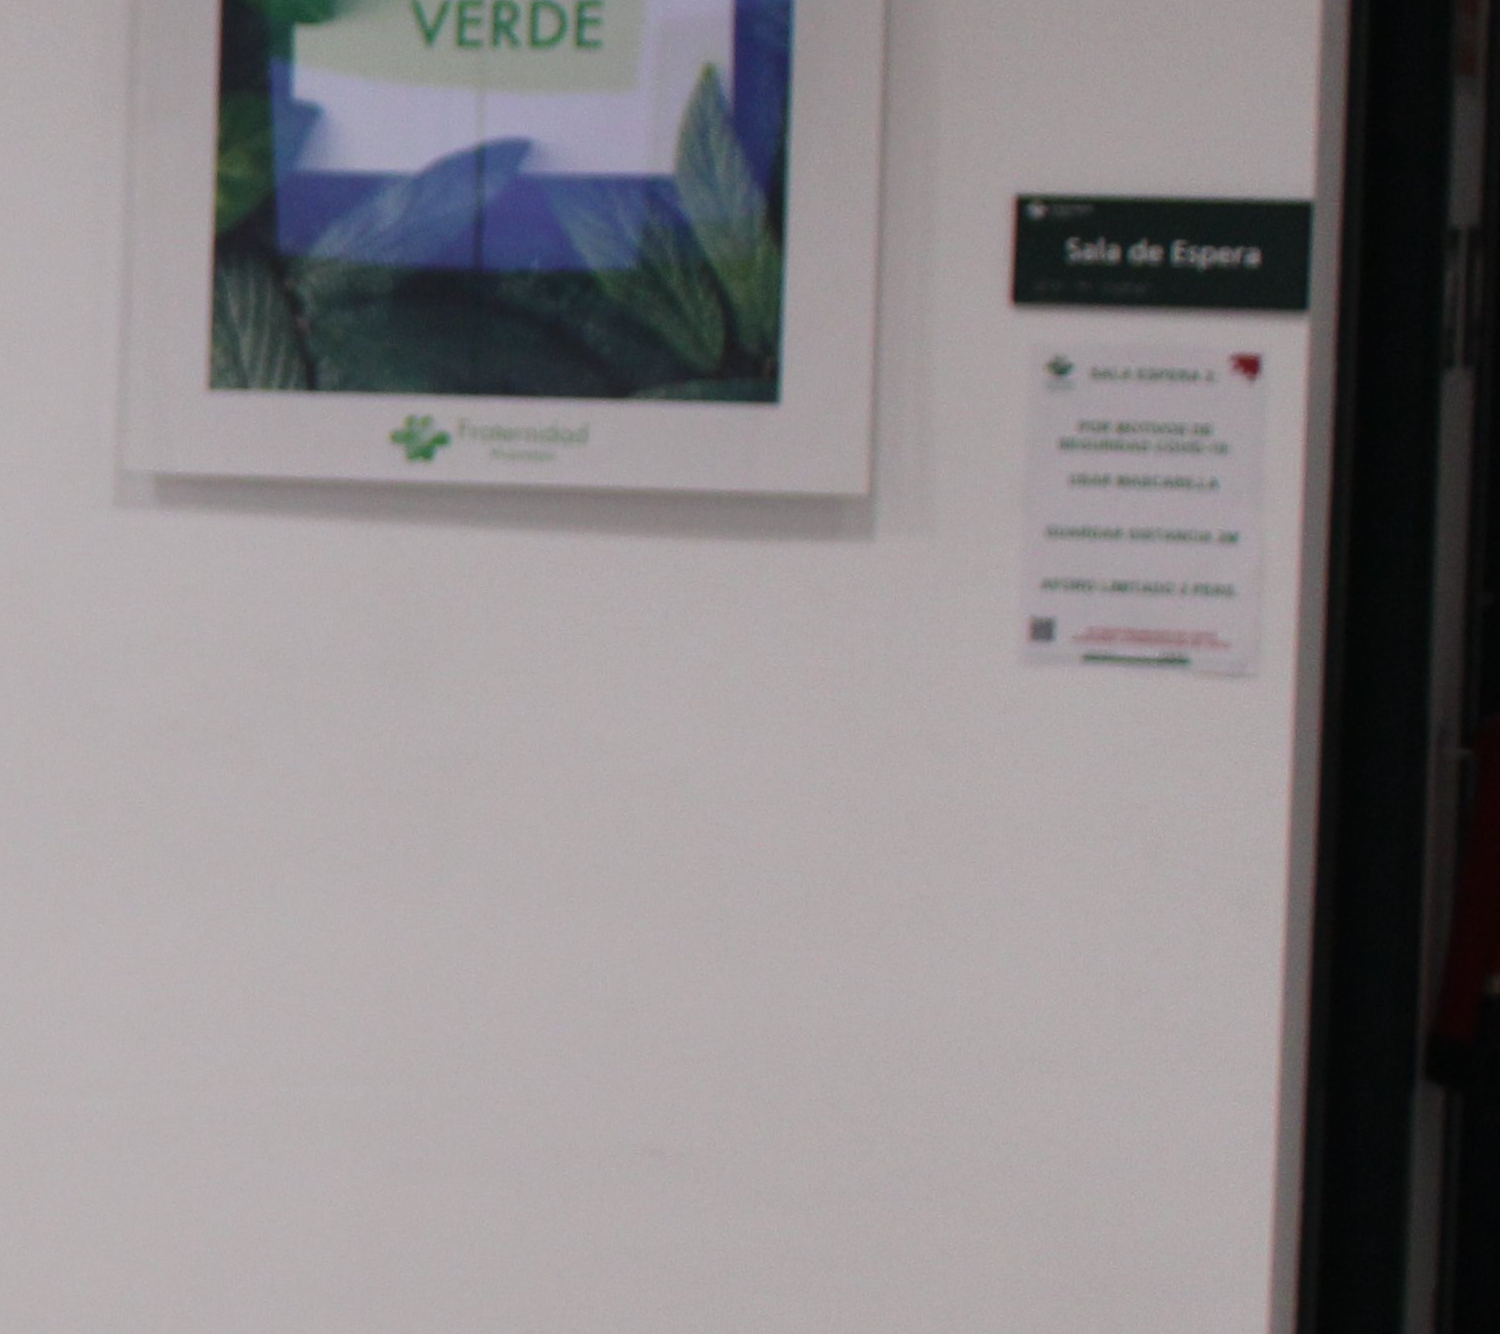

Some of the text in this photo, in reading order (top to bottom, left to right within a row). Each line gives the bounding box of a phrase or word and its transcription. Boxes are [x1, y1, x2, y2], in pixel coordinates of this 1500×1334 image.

[1064, 236, 1263, 272] Sala de Espera
